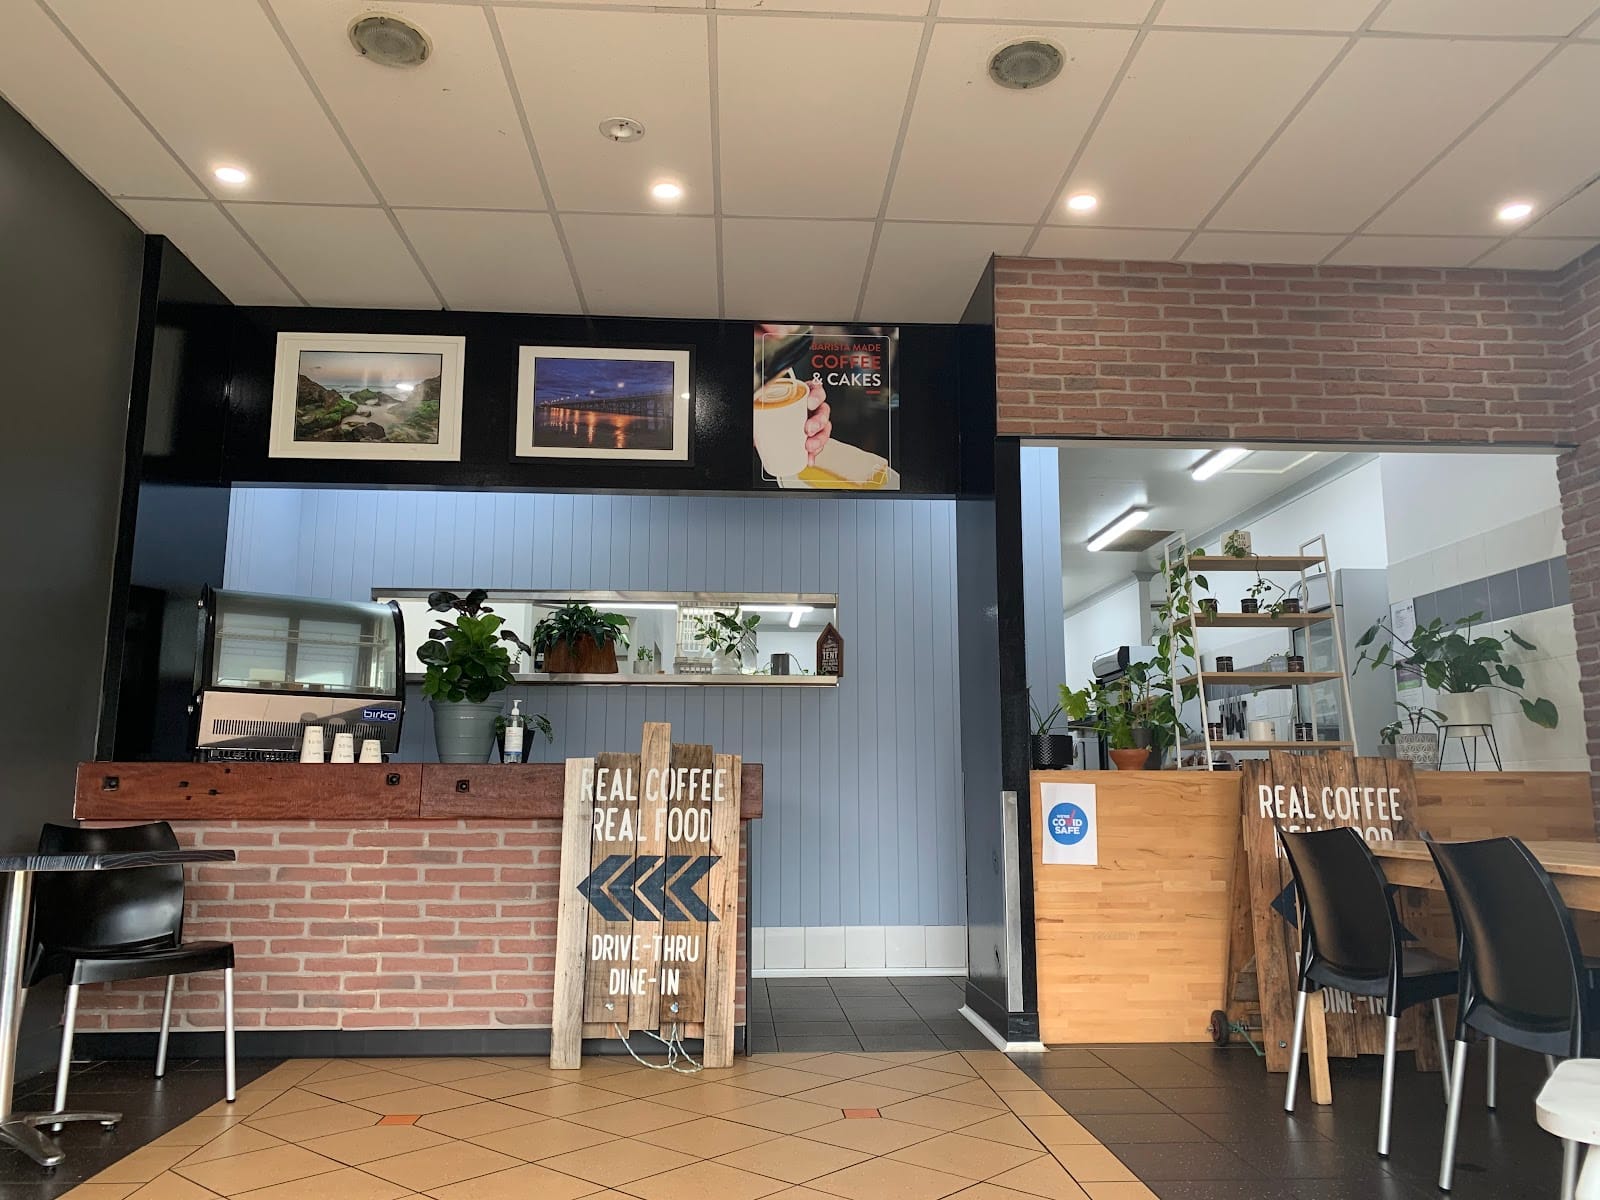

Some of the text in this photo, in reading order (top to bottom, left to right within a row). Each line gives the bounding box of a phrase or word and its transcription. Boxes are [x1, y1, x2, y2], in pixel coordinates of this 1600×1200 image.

[811, 343, 881, 352] BARISTA MADE
[811, 355, 881, 370] COFFEE
[812, 372, 881, 387] & CAKES
[580, 768, 727, 802] REAL COFFEE
[1258, 784, 1403, 821] REAL COFFEE
[593, 807, 712, 842] REAL FOOD
[1055, 826, 1080, 835] SAFE
[591, 934, 700, 962] DRIVE-THRU
[609, 968, 680, 996] DINE-IN
